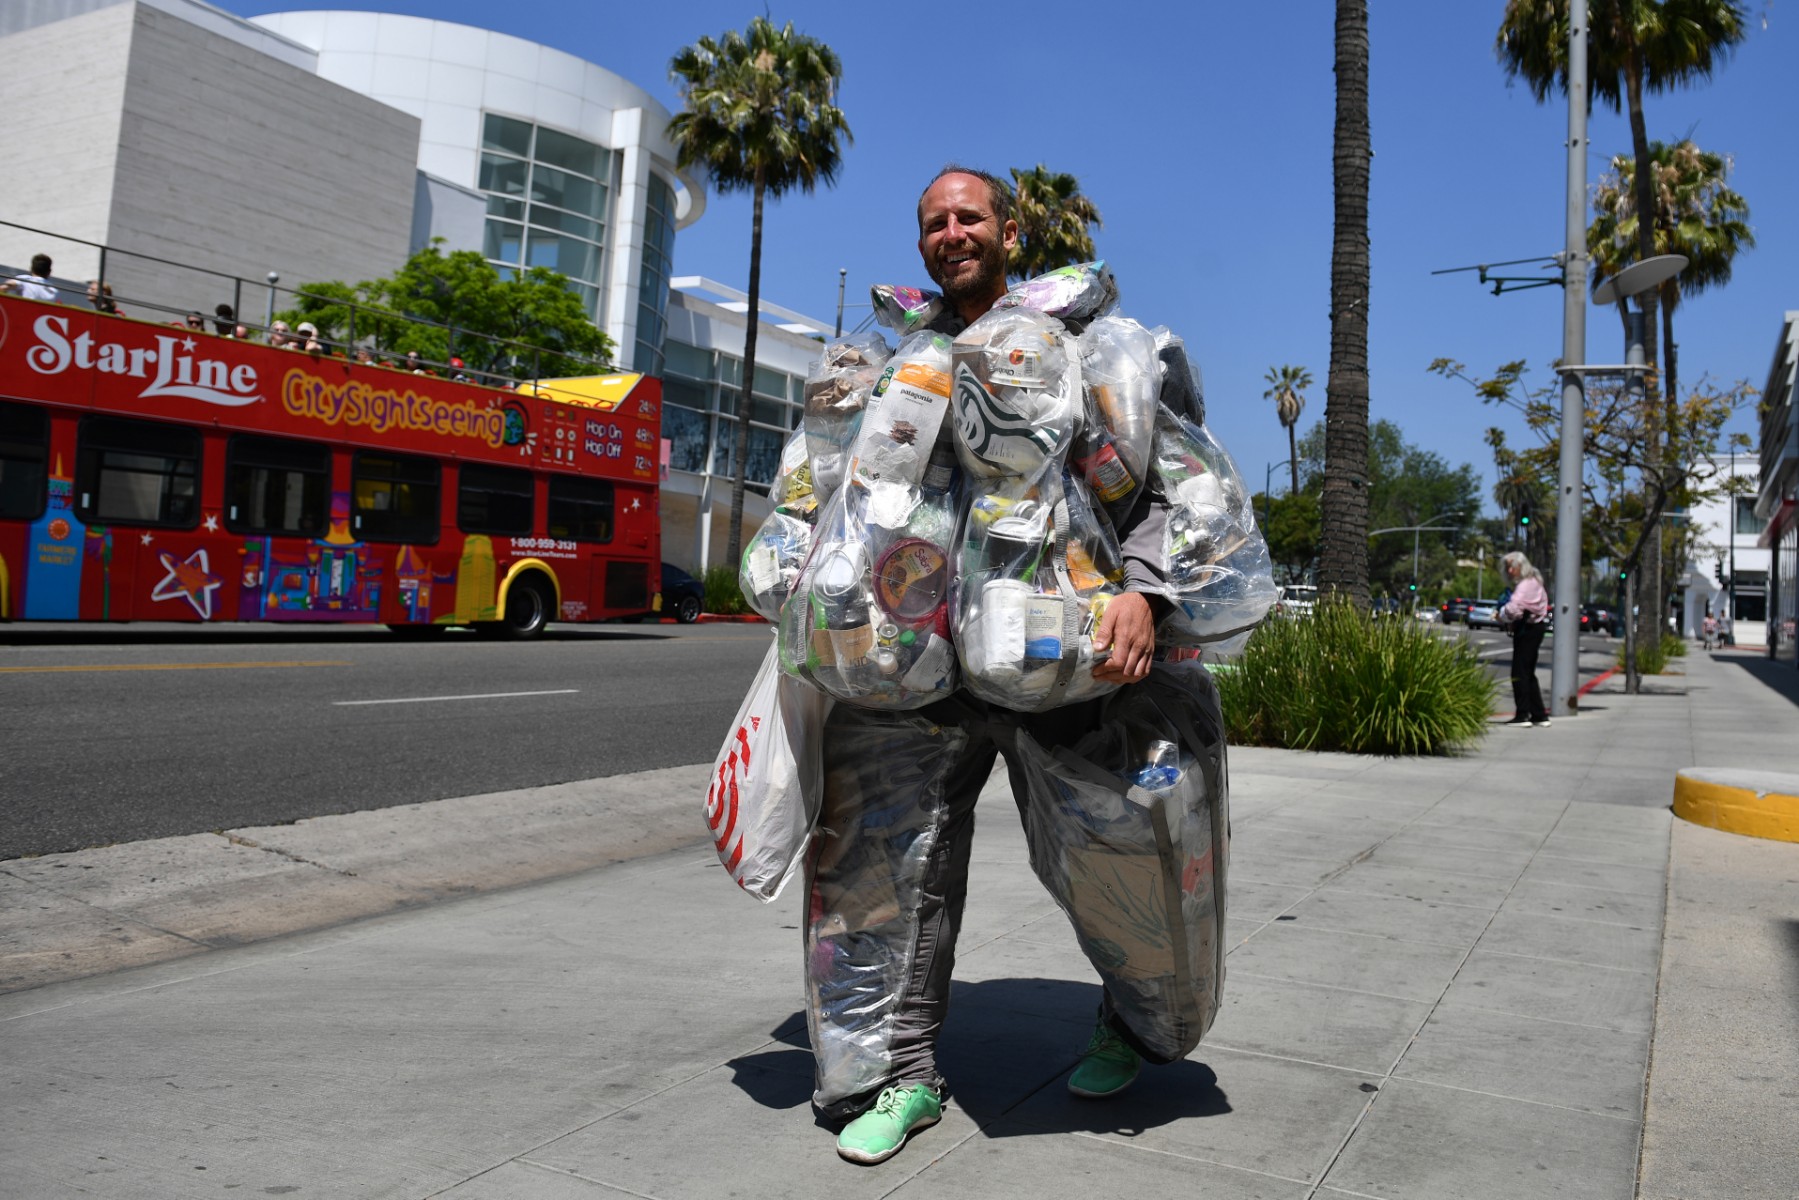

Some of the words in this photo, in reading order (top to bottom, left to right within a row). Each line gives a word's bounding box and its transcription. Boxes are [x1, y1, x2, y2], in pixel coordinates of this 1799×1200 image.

[26, 315, 262, 406] StarLine
[900, 388, 933, 403] patagonia
[283, 369, 505, 448] CitySightseeing
[586, 421, 606, 441] Hop
[608, 423, 623, 440] On
[585, 439, 604, 459] Hop
[606, 442, 622, 459] Off
[914, 548, 933, 574] Sabra
